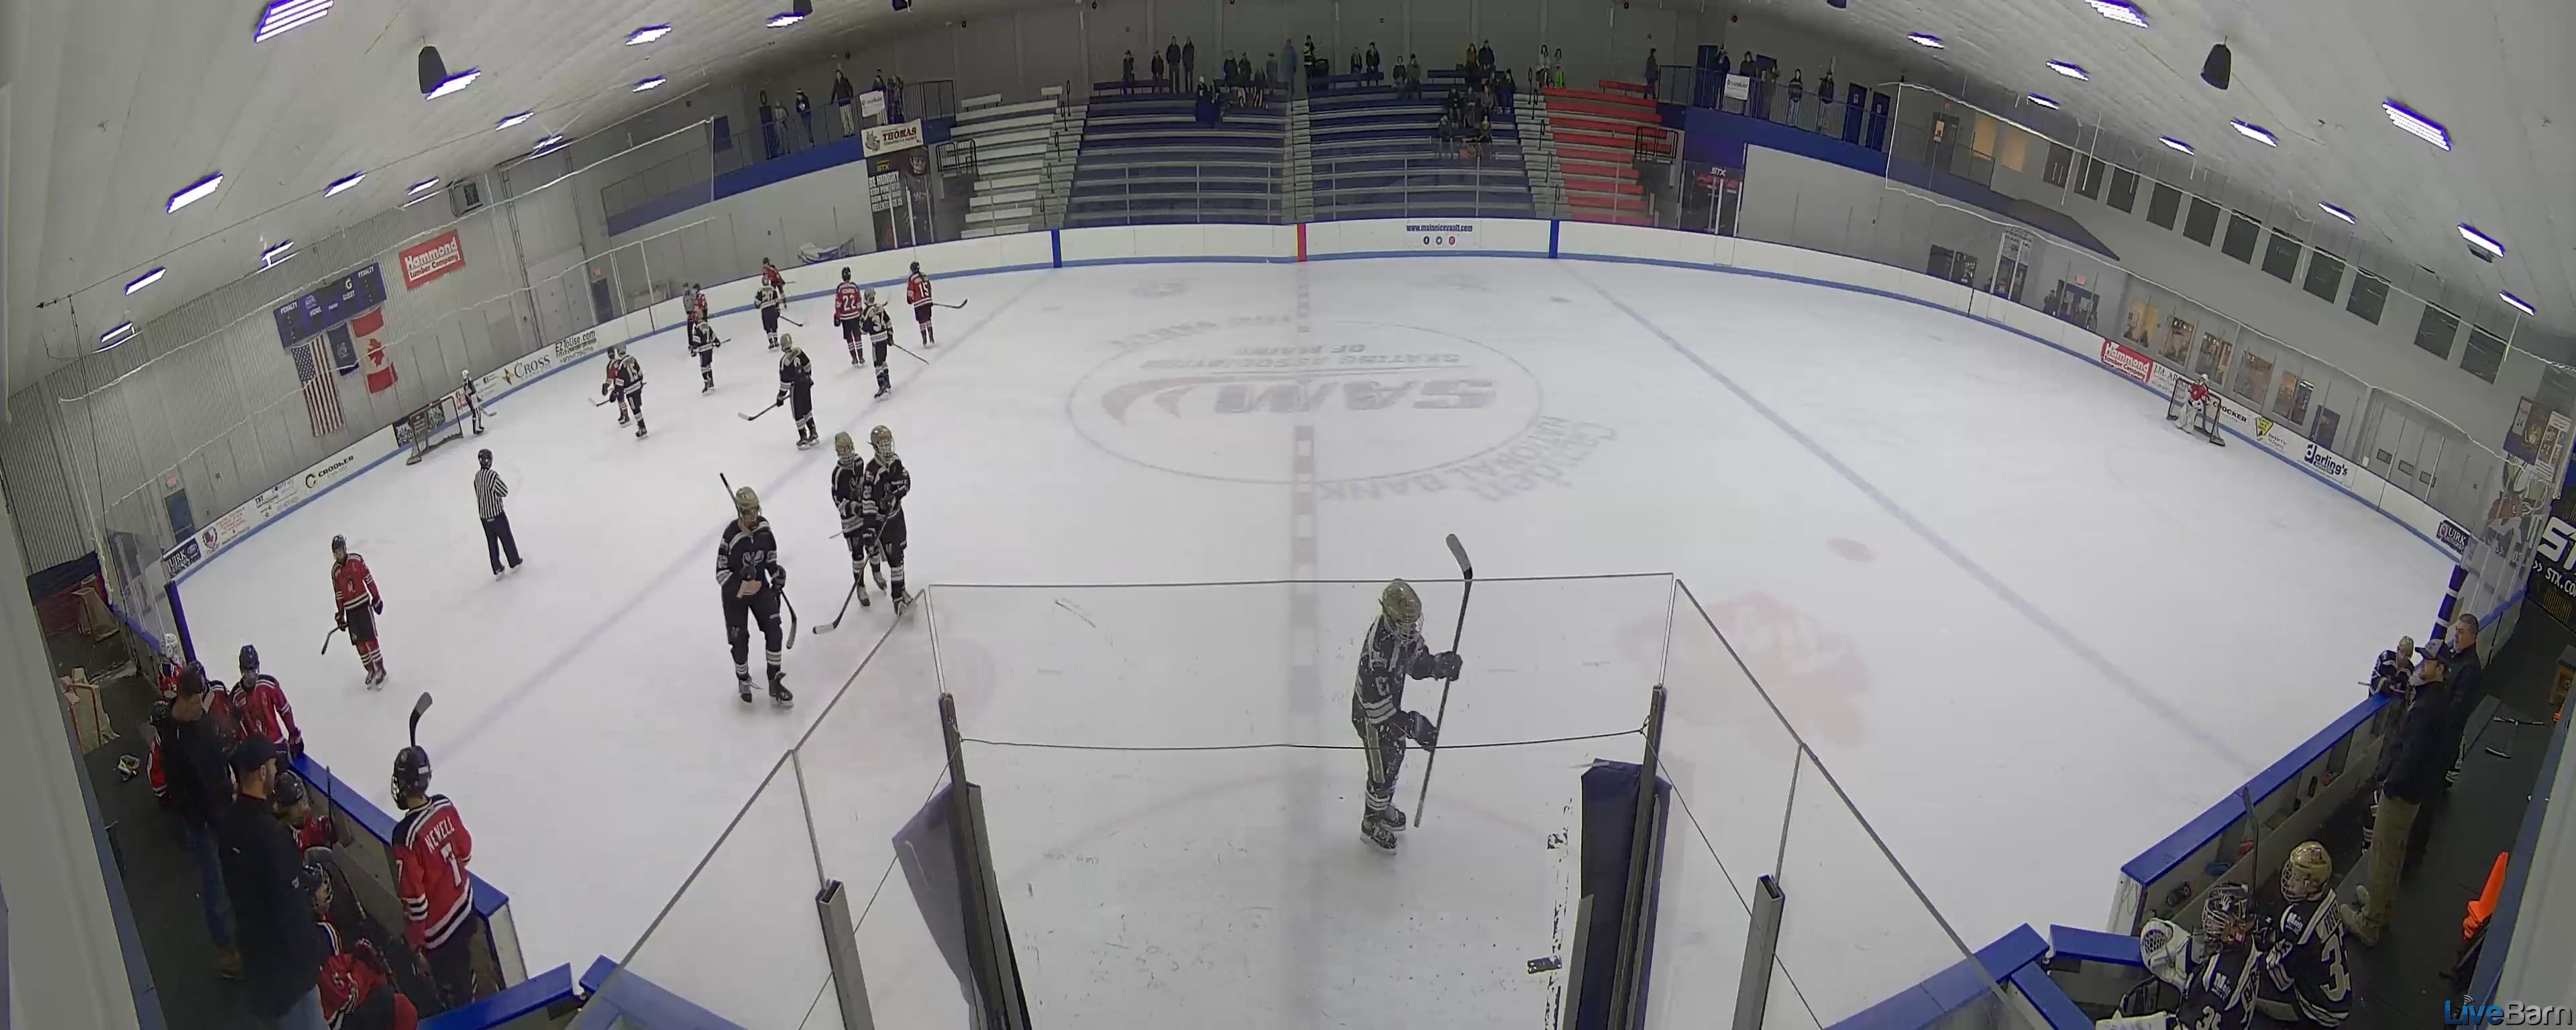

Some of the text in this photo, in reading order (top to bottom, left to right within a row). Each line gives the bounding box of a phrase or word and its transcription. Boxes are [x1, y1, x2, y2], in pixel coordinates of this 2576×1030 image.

[882, 126, 916, 141] THOMAS
[876, 170, 899, 186] HUNGRY
[405, 237, 458, 270] Hammond
[358, 266, 374, 278] PENALTY
[410, 253, 459, 278] Lumber Company
[918, 281, 930, 298] 15
[280, 301, 298, 314] PENALTY
[843, 294, 857, 312] 22
[555, 330, 596, 353] EZToUse.com
[514, 354, 551, 378] CROSS
[2105, 341, 2150, 373] Hammond
[1214, 379, 1497, 414] SAM
[318, 455, 354, 477] CROOKER
[2439, 524, 2467, 546] QUIRK
[167, 548, 186, 574] UIRK
[2545, 567, 2576, 597] STX.CO
[424, 815, 455, 854] NEWELL
[440, 842, 462, 888] 7
